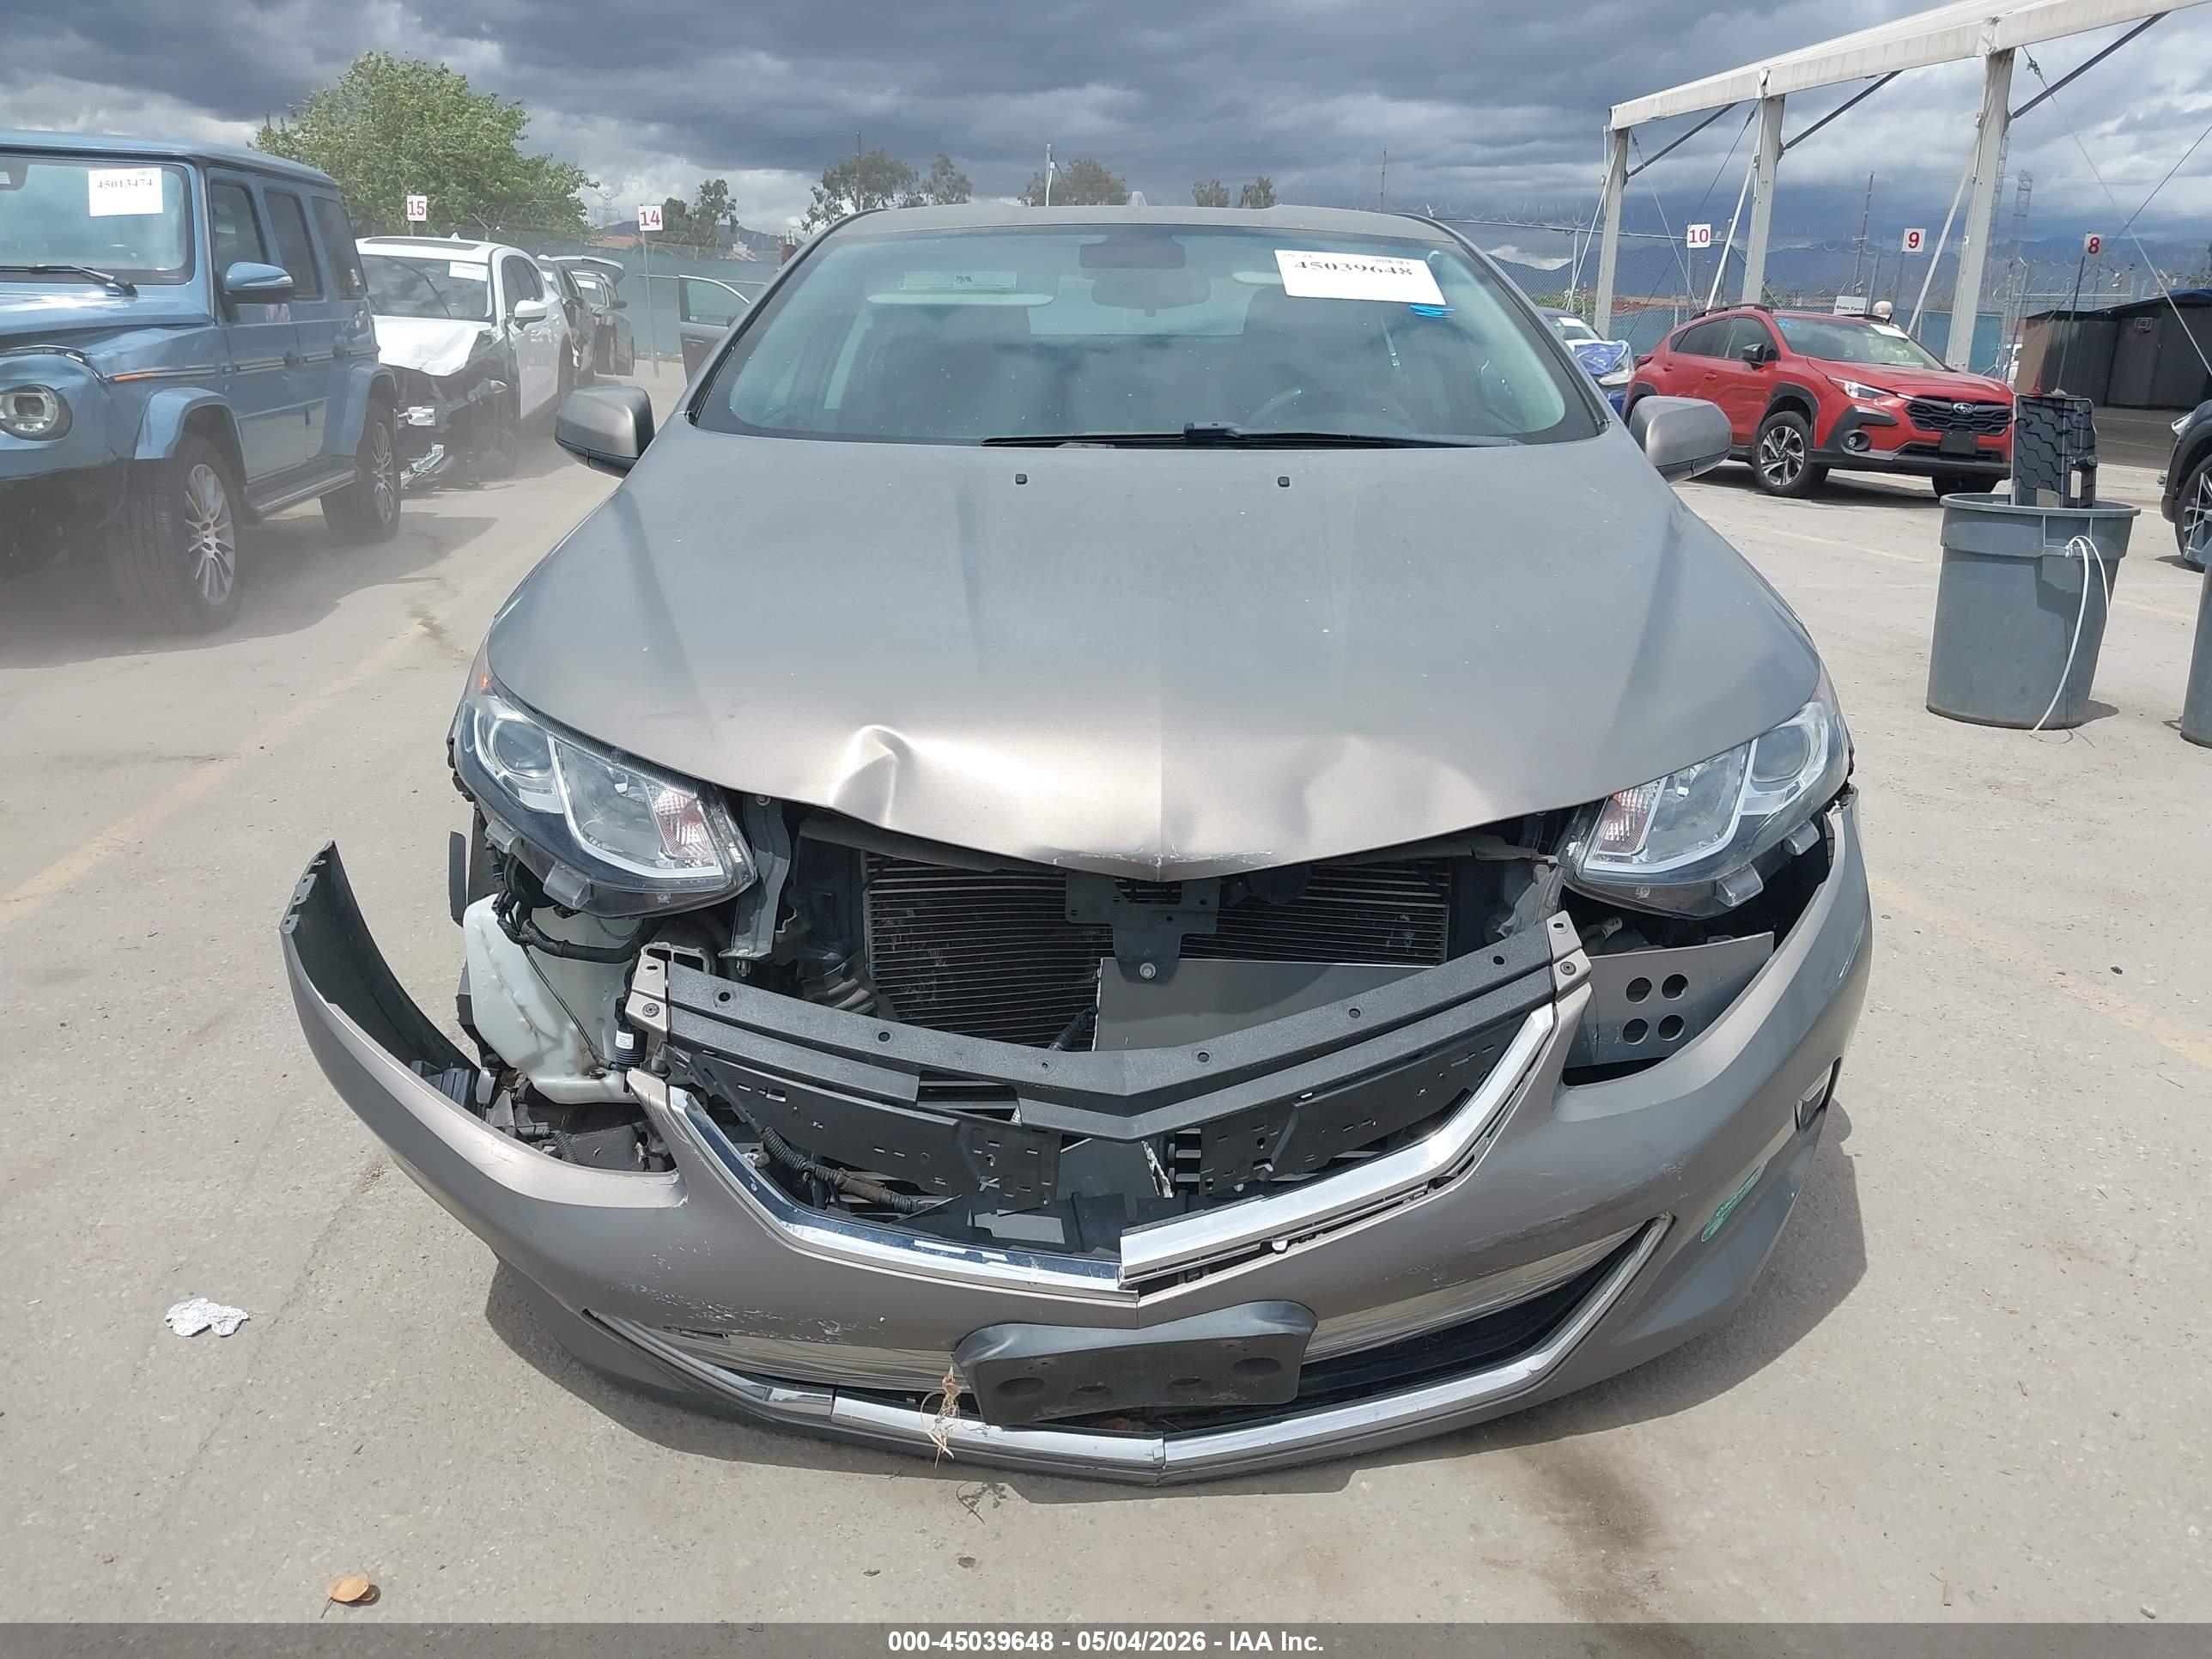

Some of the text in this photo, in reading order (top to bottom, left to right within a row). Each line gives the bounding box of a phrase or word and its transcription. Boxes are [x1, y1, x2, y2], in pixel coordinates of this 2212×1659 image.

[96, 179, 154, 190] 45013474
[408, 201, 425, 216] 15
[641, 210, 660, 226] 14
[1689, 229, 1709, 243] 10
[1908, 232, 1920, 248] 9
[2087, 237, 2100, 254] 8
[1293, 260, 1413, 276] 45039648
